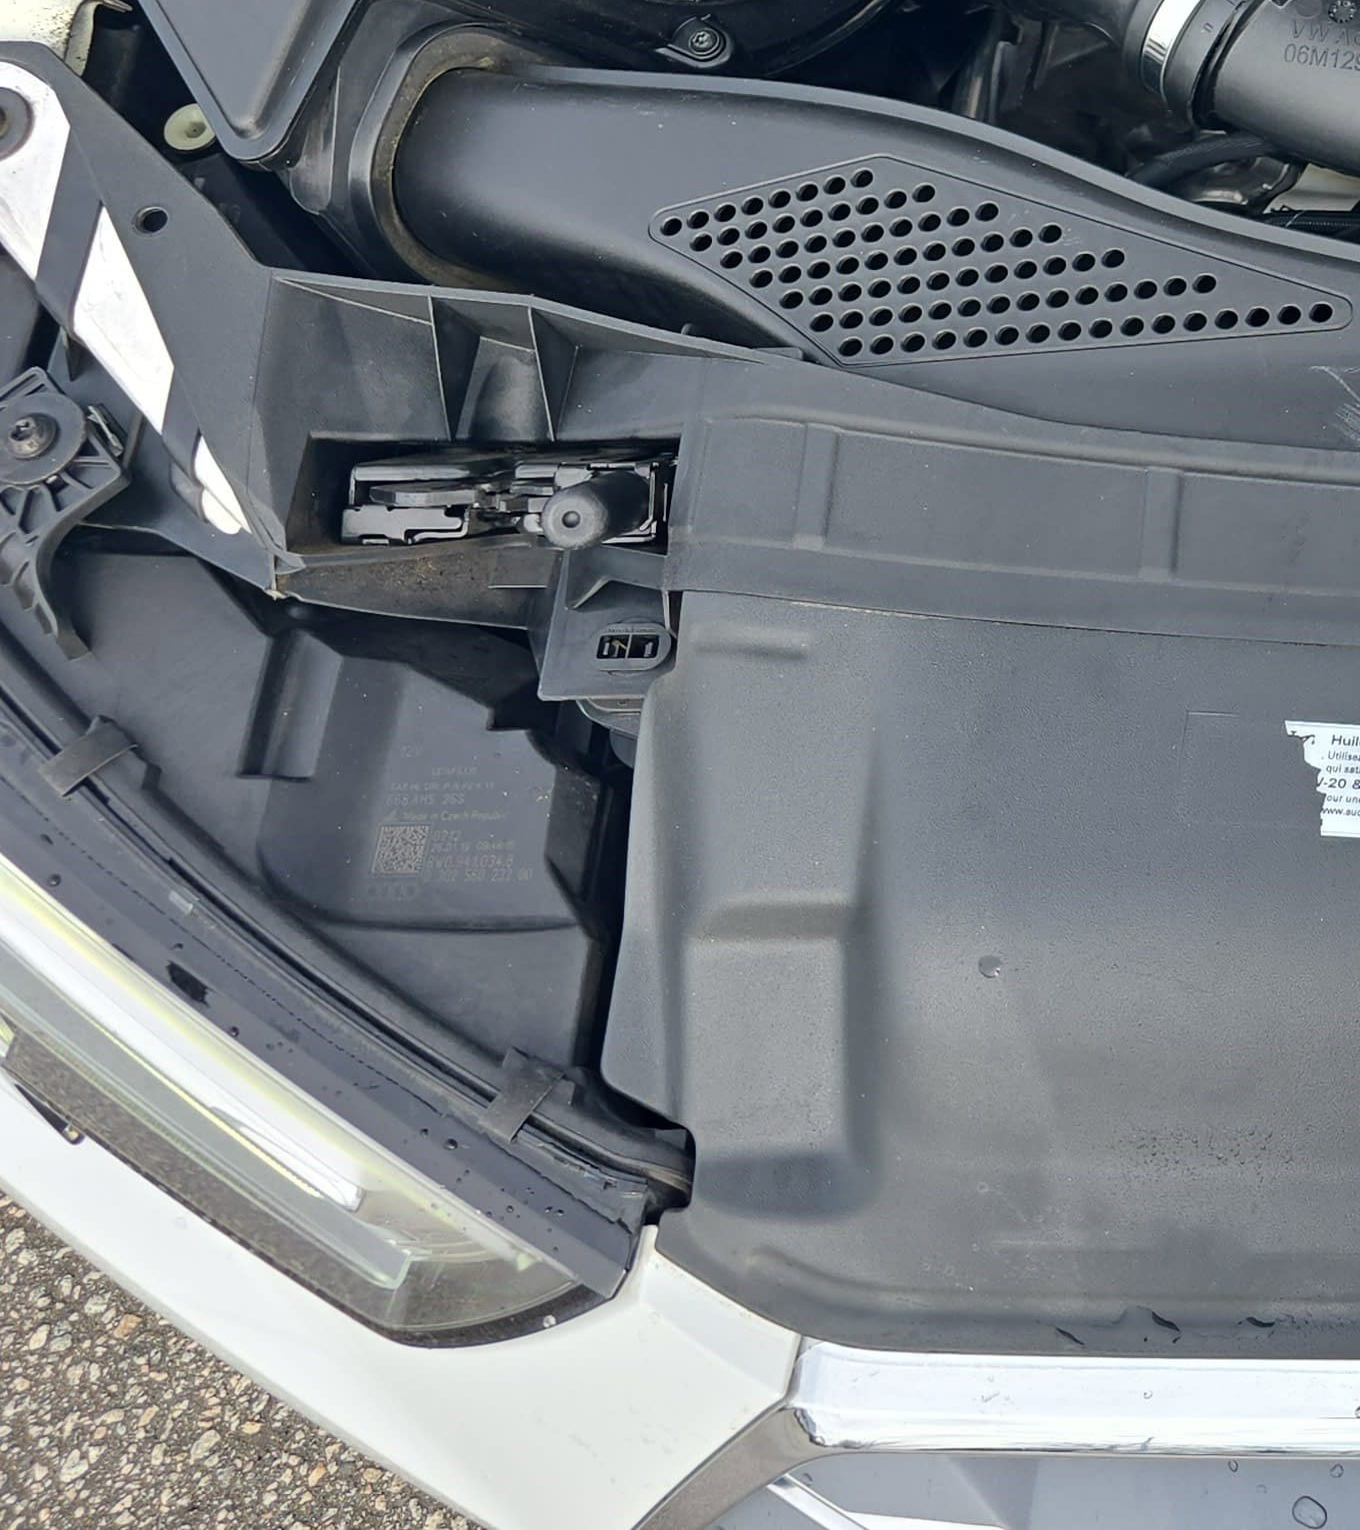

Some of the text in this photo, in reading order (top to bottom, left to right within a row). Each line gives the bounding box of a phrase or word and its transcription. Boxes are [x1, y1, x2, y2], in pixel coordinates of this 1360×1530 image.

[1291, 19, 1327, 42] VW
[1326, 764, 1342, 775] qui
[1323, 794, 1343, 803] our
